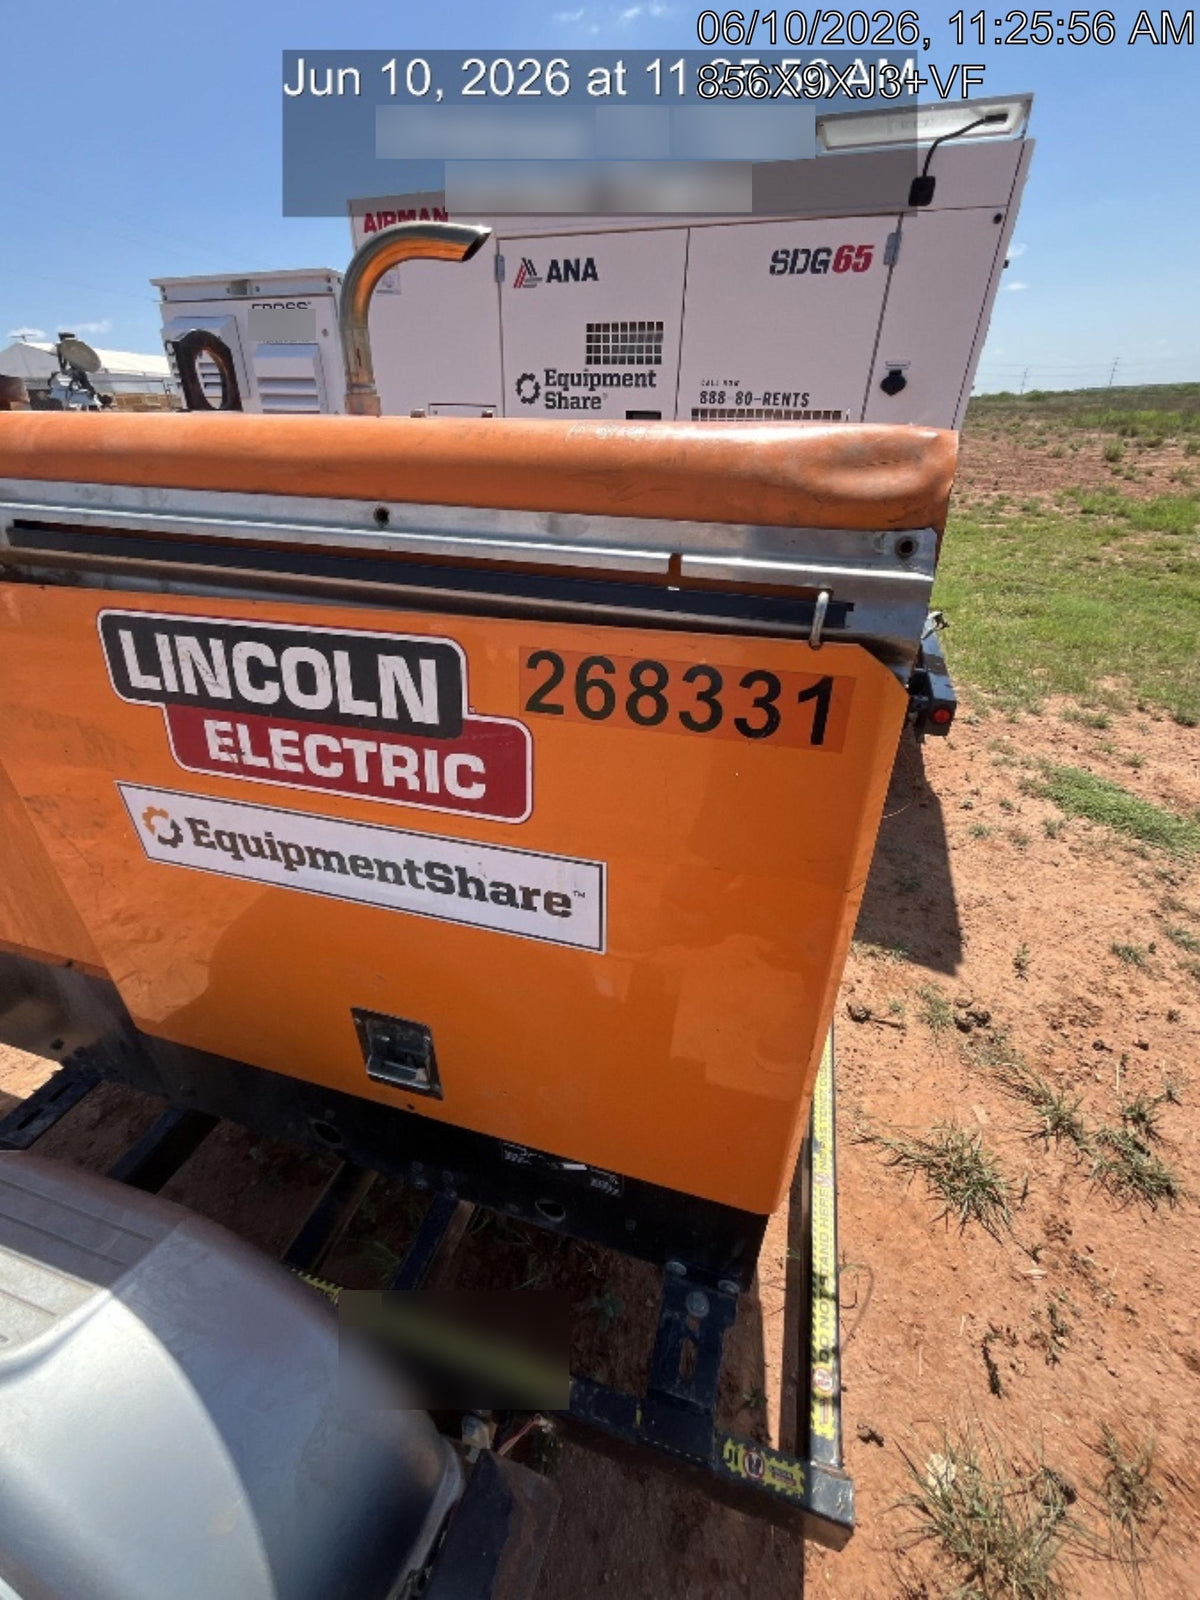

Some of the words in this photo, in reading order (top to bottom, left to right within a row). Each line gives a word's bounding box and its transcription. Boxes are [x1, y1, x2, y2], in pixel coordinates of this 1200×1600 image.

[364, 206, 448, 233] AIRMAN
[546, 257, 599, 283] ANA
[769, 244, 875, 276] SDG65
[544, 368, 657, 391] Equipment
[544, 391, 602, 409] Share
[117, 630, 441, 726] LINCOLN
[524, 650, 834, 746] 268331
[203, 719, 487, 801] ELECTRIC
[819, 1288, 830, 1331] NOT
